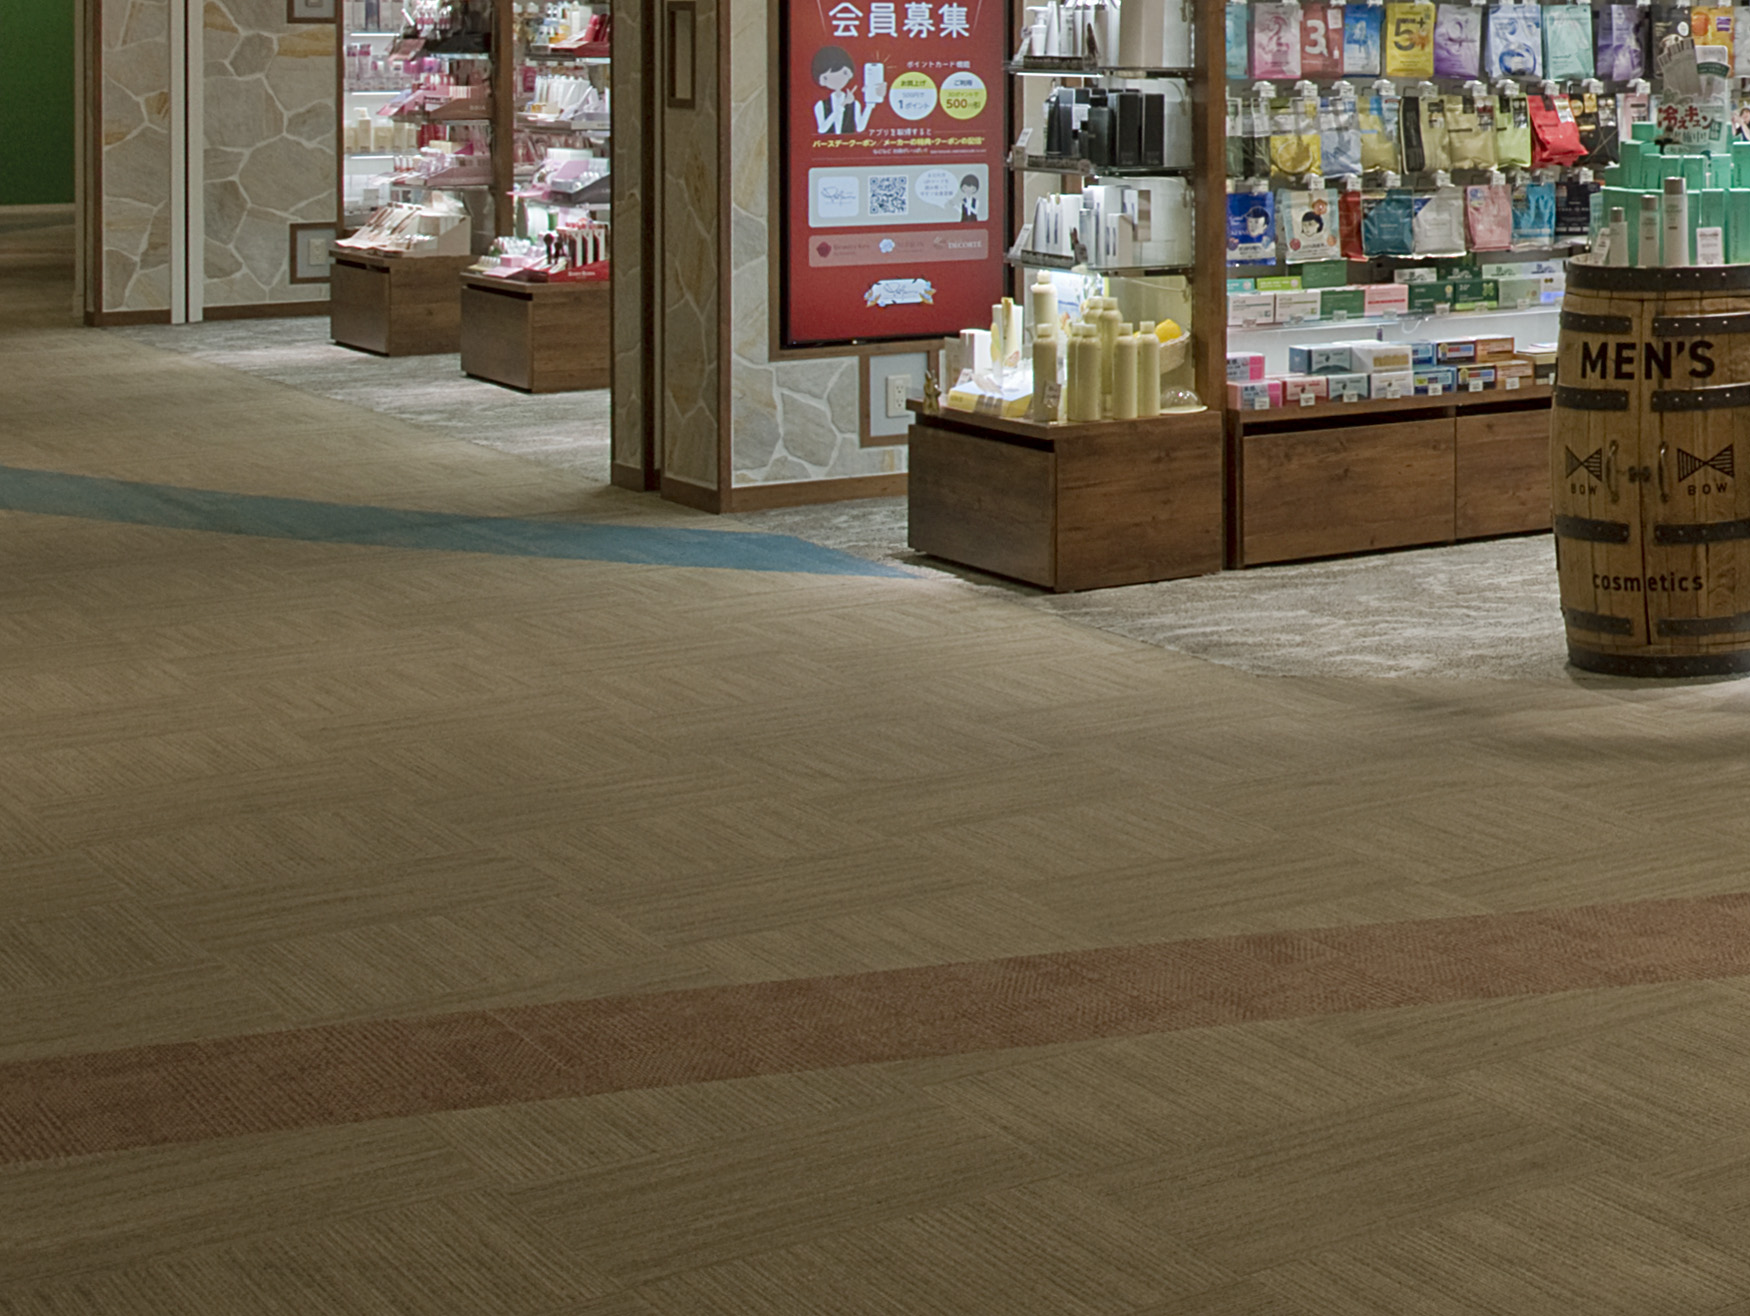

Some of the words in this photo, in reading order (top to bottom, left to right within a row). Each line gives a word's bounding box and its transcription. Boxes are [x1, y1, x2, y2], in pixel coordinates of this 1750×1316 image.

[828, 2, 970, 38] 会員募集
[1580, 340, 1717, 381] MEN'S
[1570, 482, 1599, 497] BOW
[1687, 481, 1729, 497] BOW
[1592, 571, 1704, 594] cosmetics
